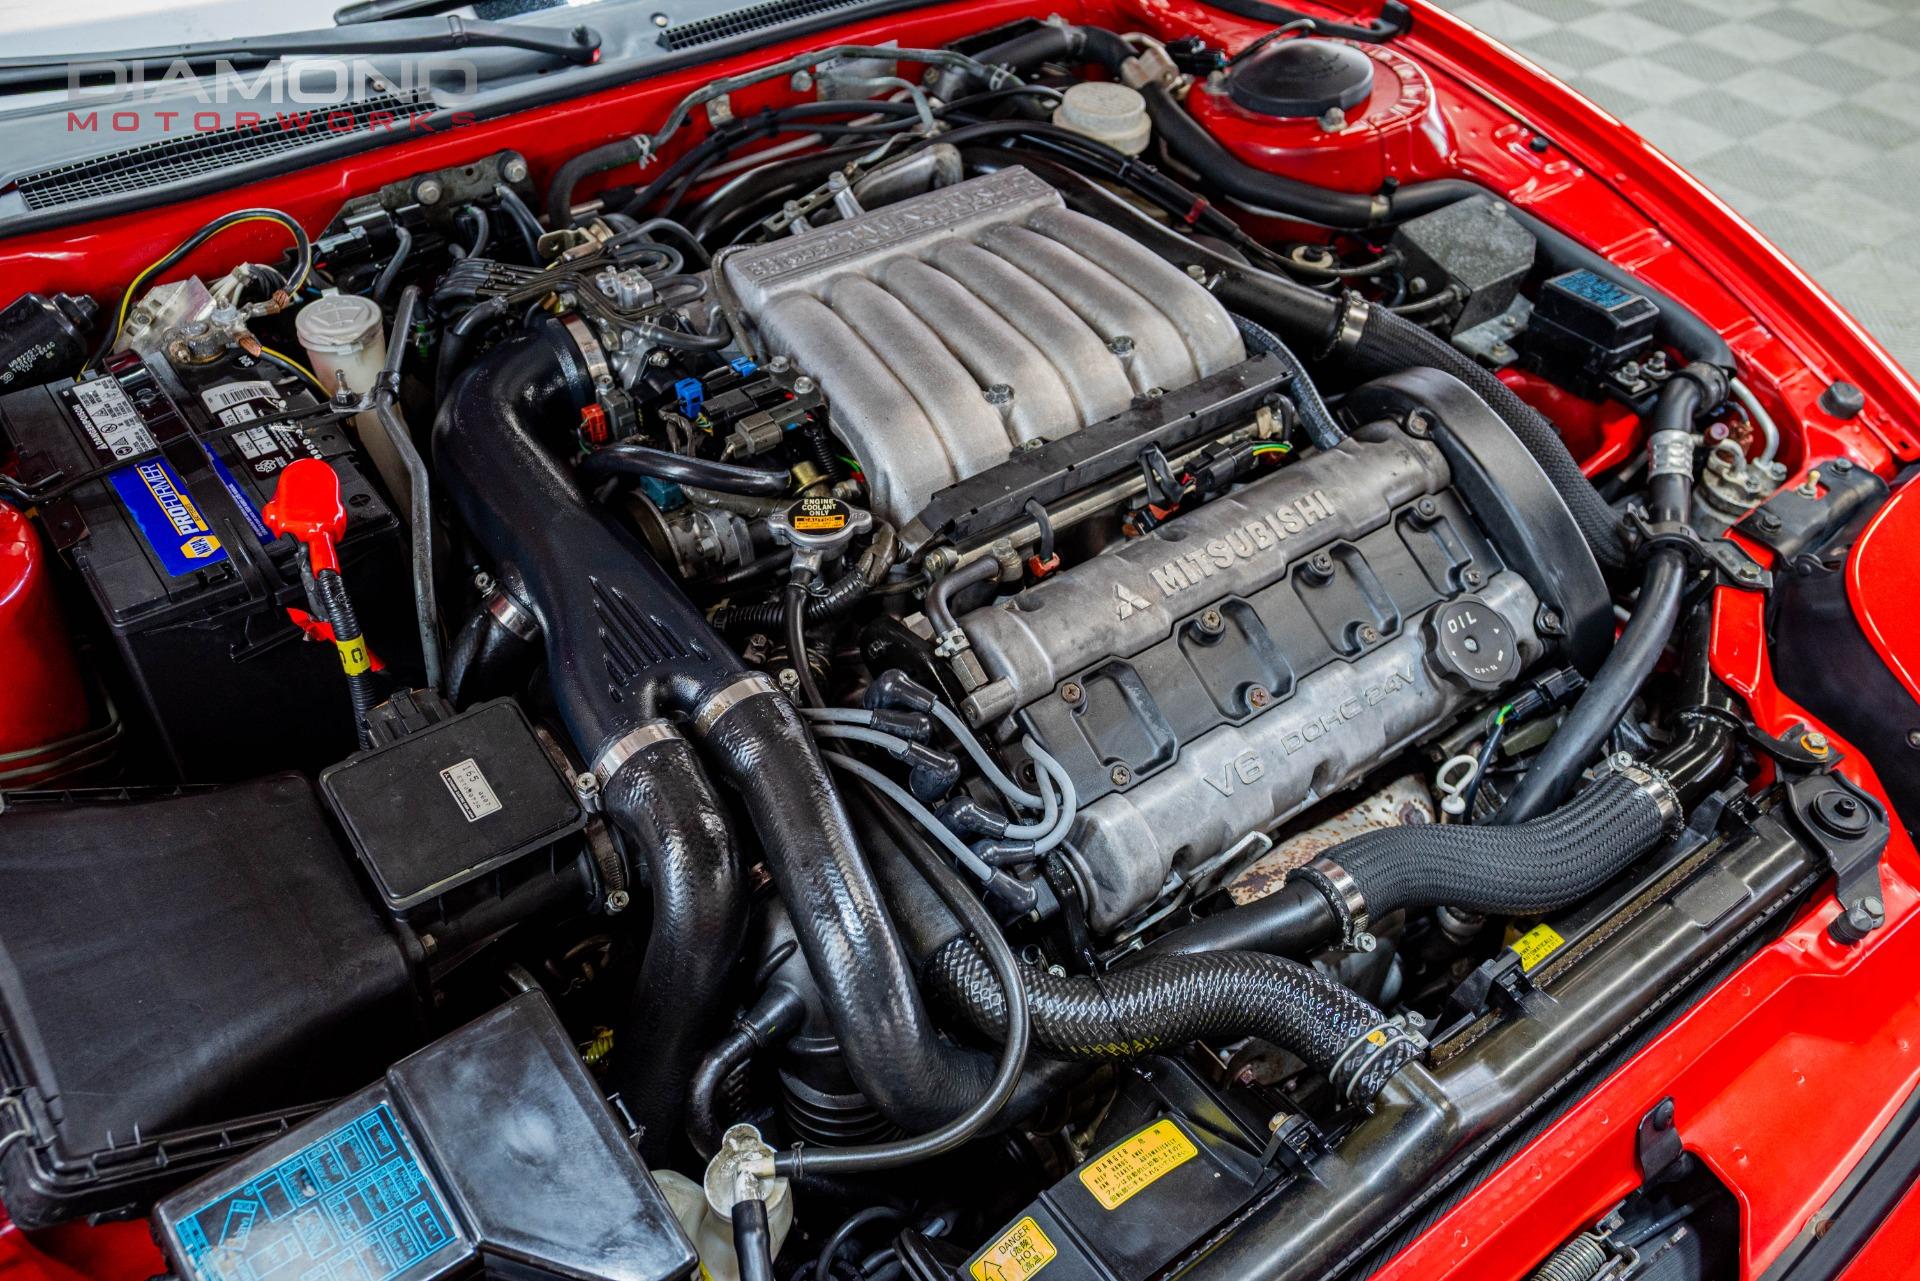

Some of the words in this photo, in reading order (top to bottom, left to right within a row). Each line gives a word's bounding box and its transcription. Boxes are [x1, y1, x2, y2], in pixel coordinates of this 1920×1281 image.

[140, 464, 200, 535] PROFORMER
[190, 537, 213, 556] NAPA
[1151, 490, 1335, 598] MITSUBISHI
[1447, 611, 1477, 634] OIL
[1203, 750, 1266, 798] V6
[1281, 695, 1362, 756] DOHC
[1363, 664, 1416, 707] 24V
[462, 766, 479, 782] 165
[1096, 1148, 1128, 1172] DANGER
[404, 1160, 424, 1185] FUSE
[998, 1225, 1031, 1255] DANGER
[1016, 1245, 1037, 1266] HOT
